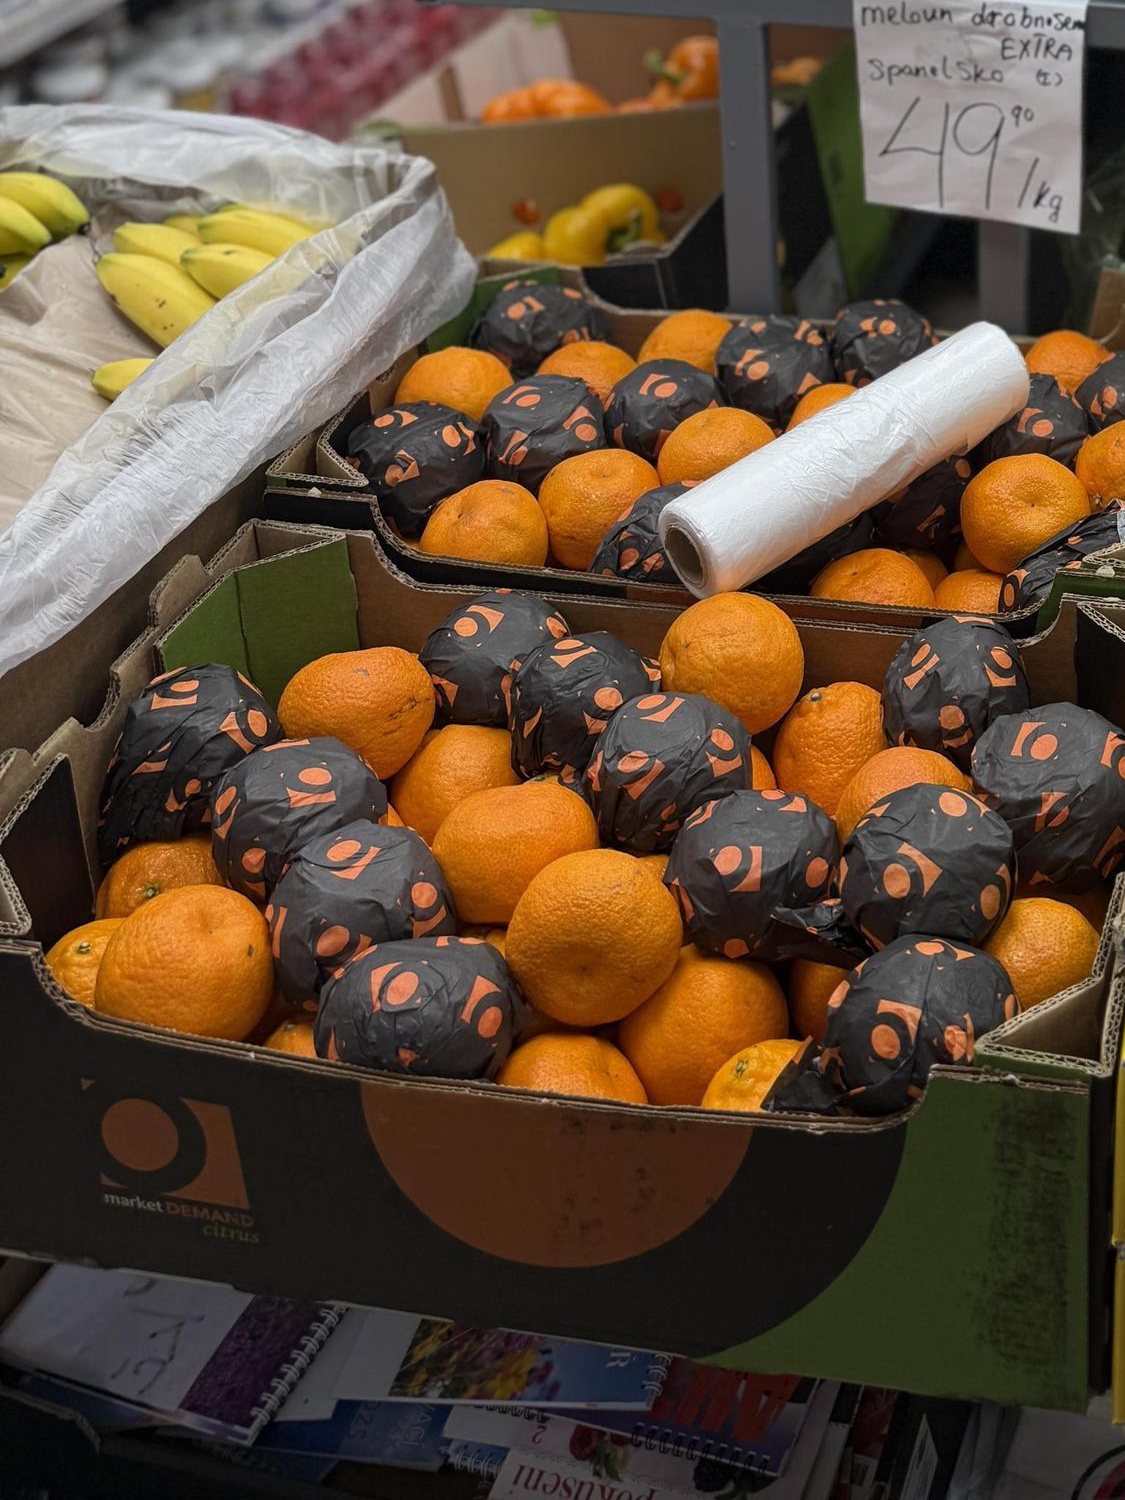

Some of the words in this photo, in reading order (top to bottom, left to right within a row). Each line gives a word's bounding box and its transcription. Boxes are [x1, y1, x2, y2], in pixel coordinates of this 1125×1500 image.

[861, 1, 953, 27] meloun
[1001, 33, 1073, 62] EXTRA
[879, 96, 1006, 211] 49
[104, 1192, 164, 1213] market
[166, 1201, 254, 1228] DEMAND
[203, 1221, 261, 1245] citrus
